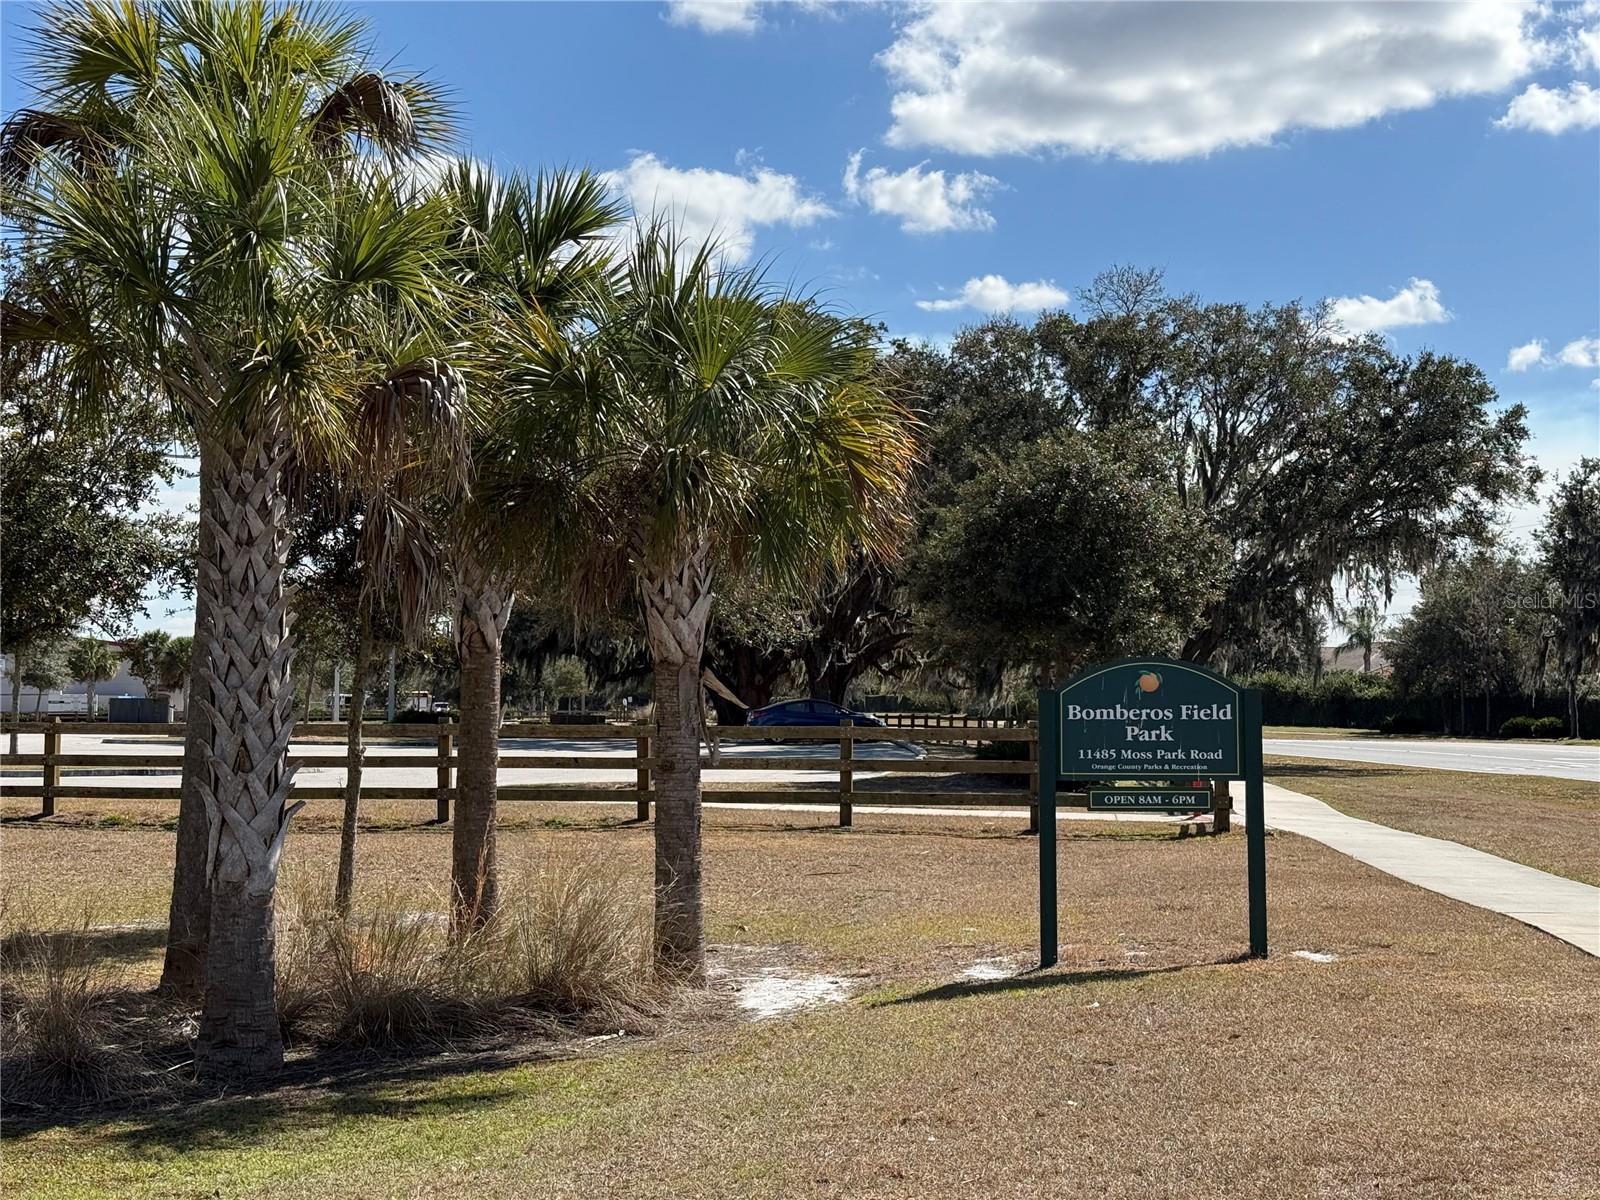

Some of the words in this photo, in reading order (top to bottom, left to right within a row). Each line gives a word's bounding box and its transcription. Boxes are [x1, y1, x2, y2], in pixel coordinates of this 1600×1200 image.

[1067, 704, 1173, 721] Bomberos
[1179, 704, 1233, 720] Field
[1125, 726, 1175, 742] Park
[1078, 749, 1116, 760] 11485
[1120, 749, 1153, 760] Moss
[1157, 749, 1187, 760] Park
[1190, 749, 1223, 760] Road
[1091, 763, 1117, 771] Orange
[1117, 763, 1142, 771] County
[1104, 795, 1137, 804] OPEN
[1138, 795, 1164, 804] 8AM
[1171, 795, 1196, 804] 6PM
